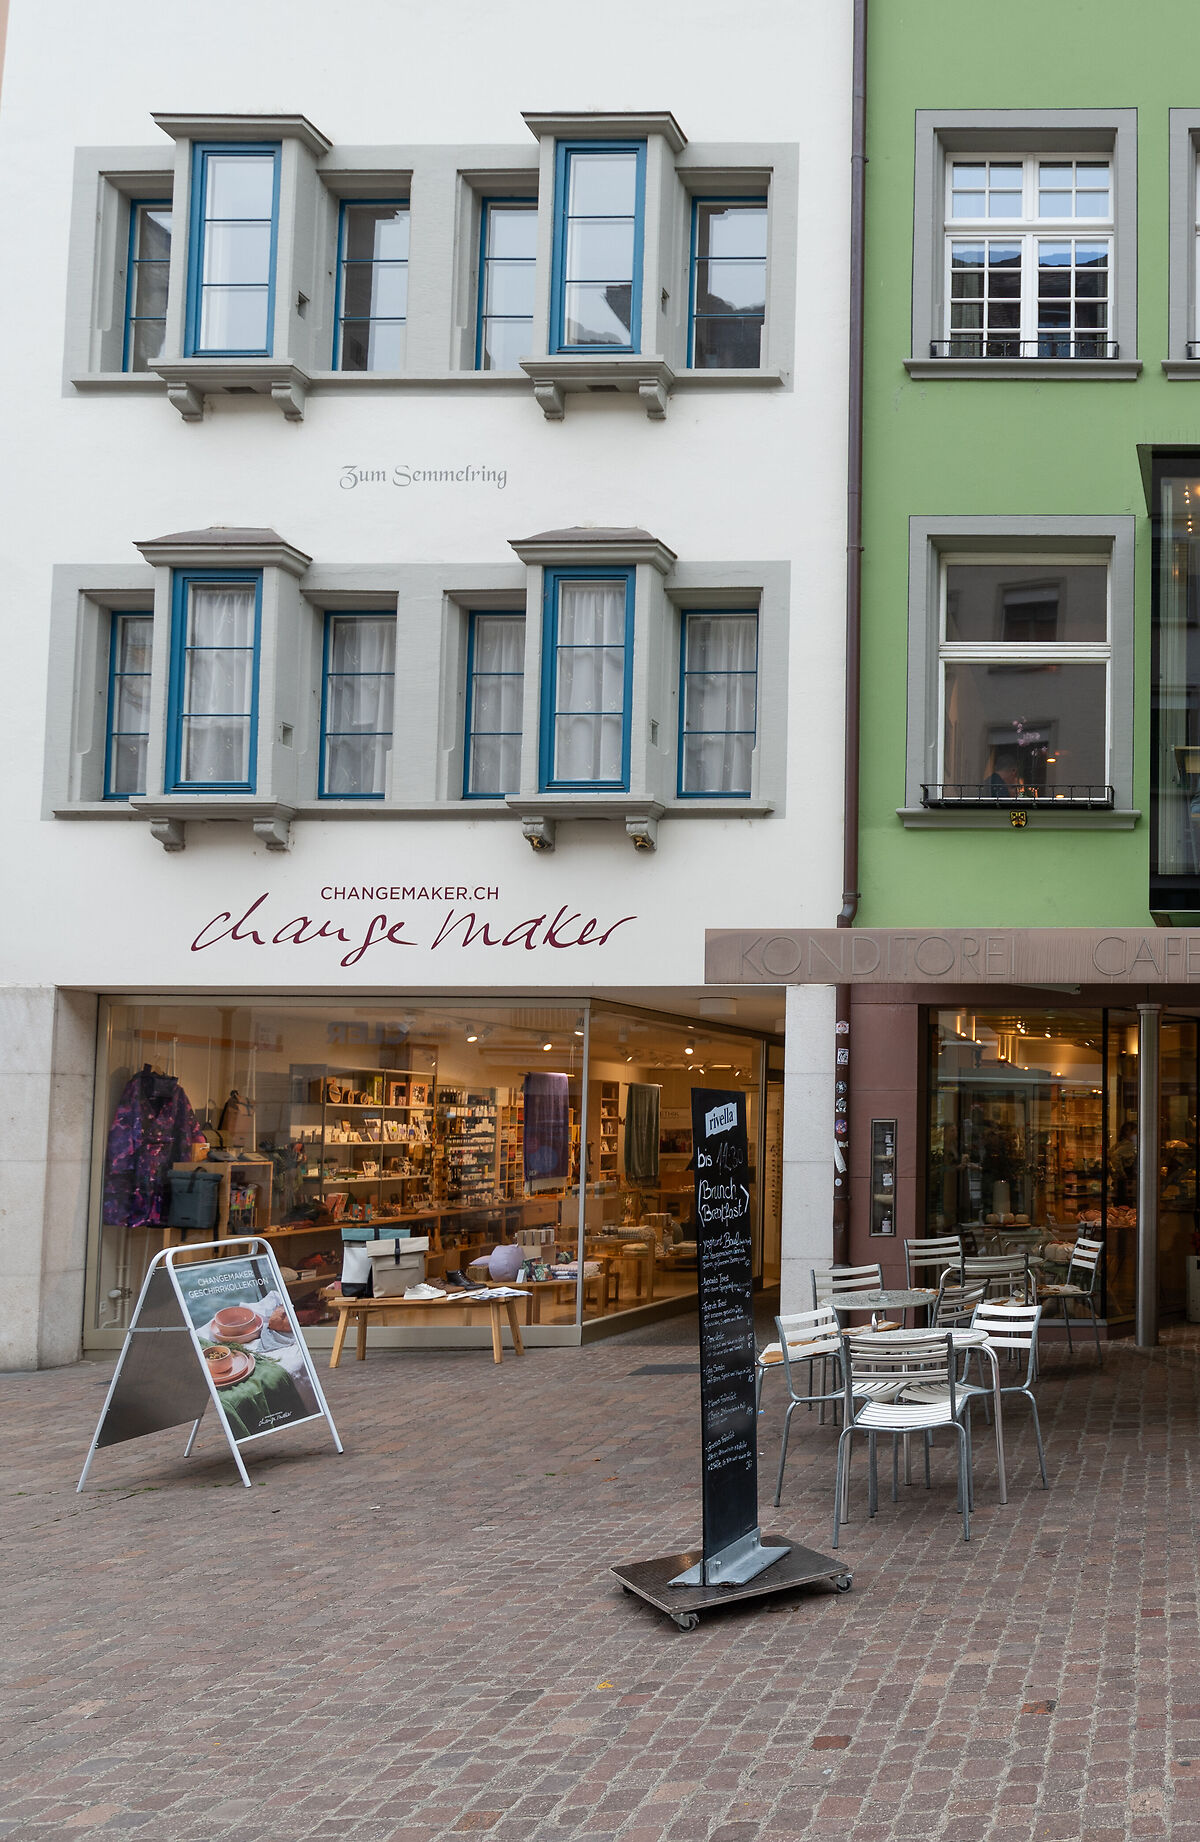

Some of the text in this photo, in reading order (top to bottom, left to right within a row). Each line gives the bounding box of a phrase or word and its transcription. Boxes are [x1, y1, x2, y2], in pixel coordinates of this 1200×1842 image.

[339, 464, 508, 490] Zum Semmelring
[320, 885, 500, 901] CHANGEMAKER.CH
[190, 892, 638, 968] change maker
[740, 935, 1016, 976] KONDITOREI
[709, 1107, 734, 1131] rivella
[697, 1146, 713, 1169] bis
[188, 1277, 270, 1299] GESCHIRRKOLLEKTION
[197, 1269, 255, 1287] CHANGEMAKER
